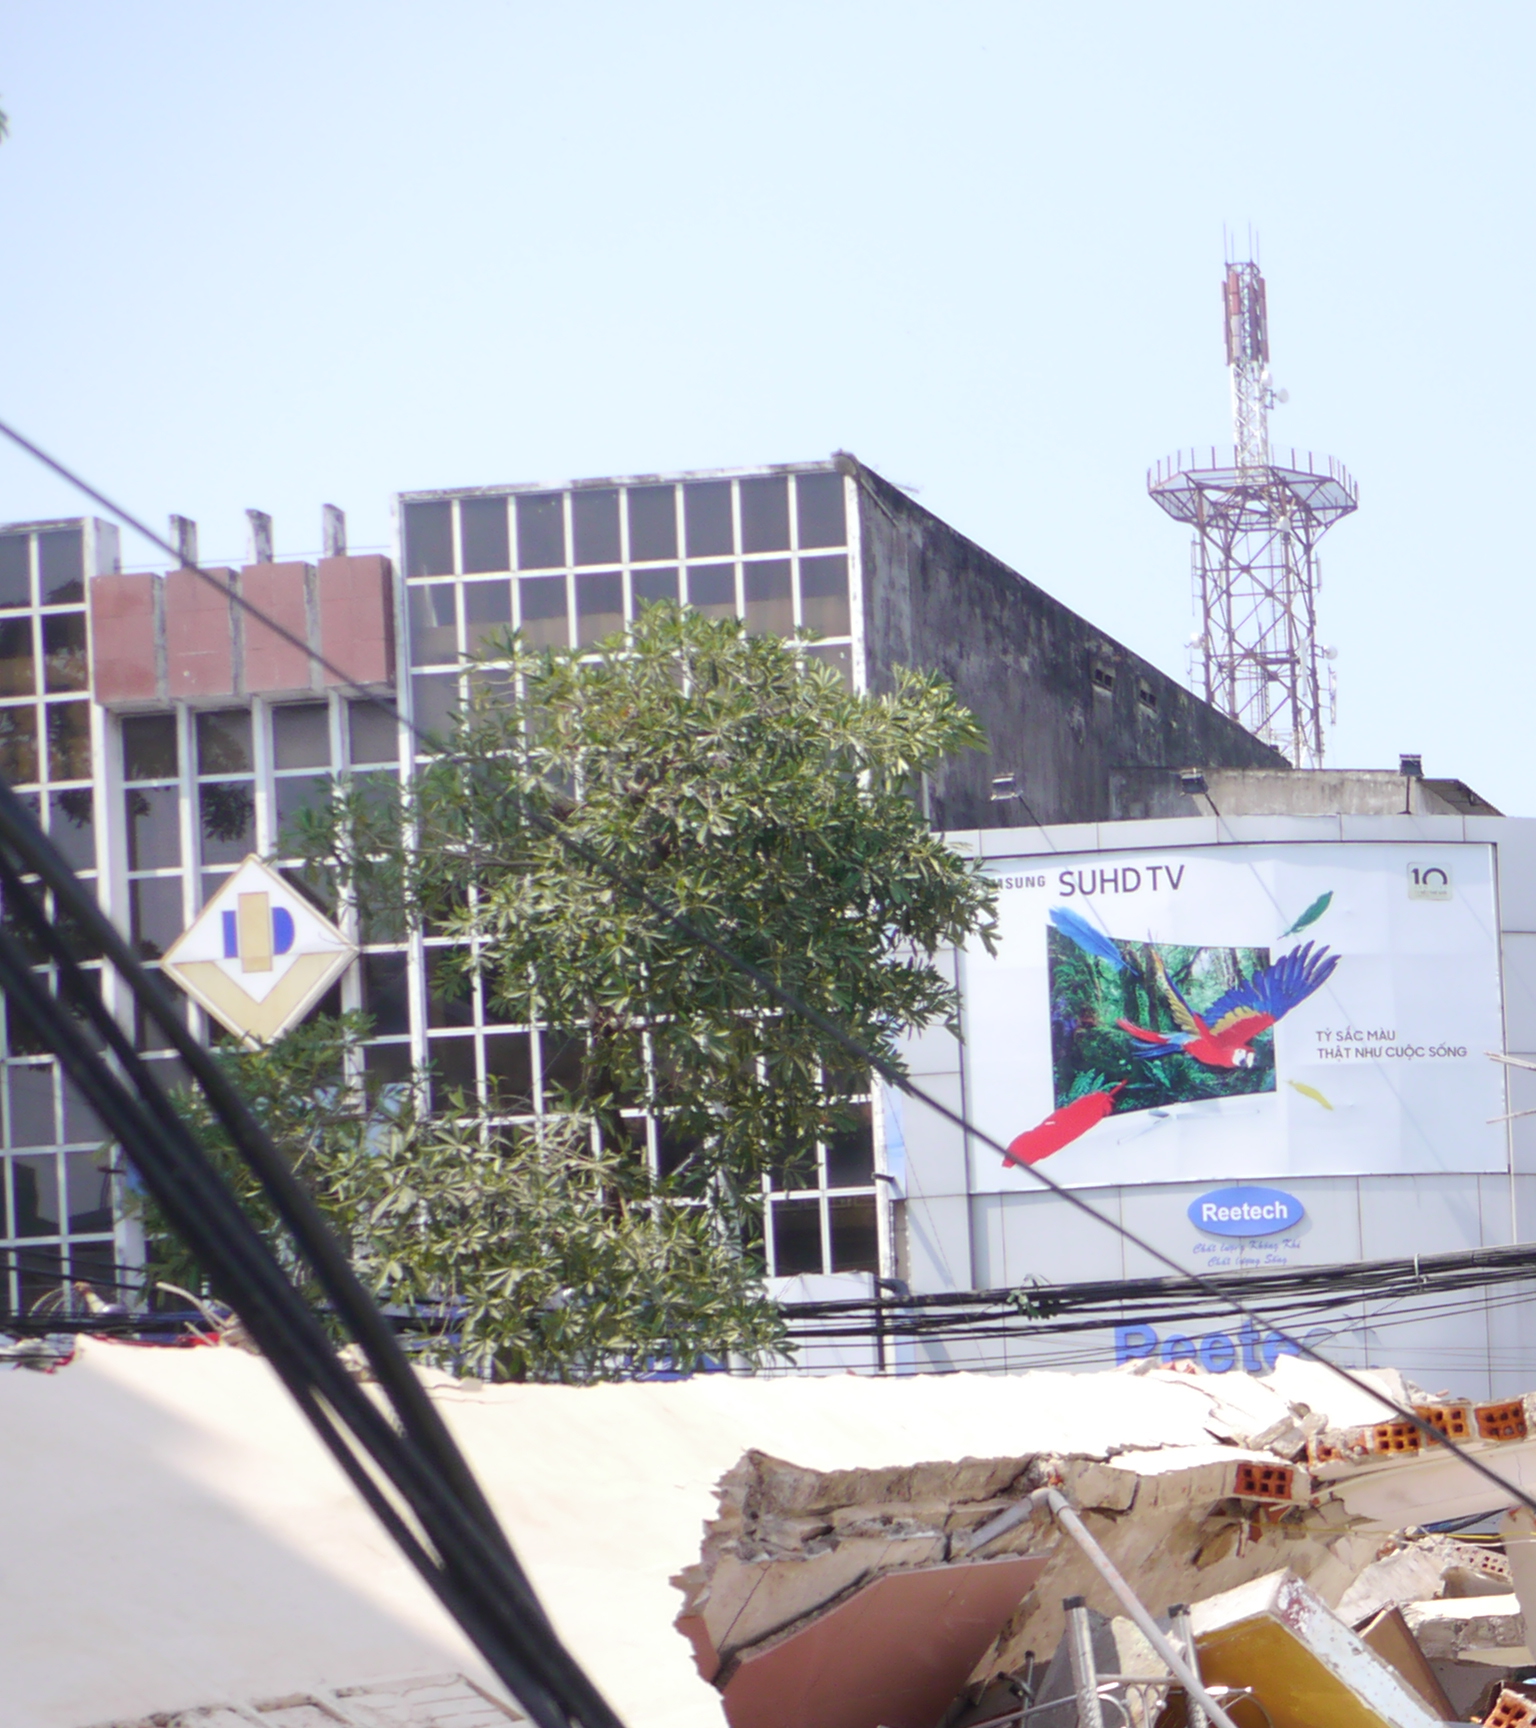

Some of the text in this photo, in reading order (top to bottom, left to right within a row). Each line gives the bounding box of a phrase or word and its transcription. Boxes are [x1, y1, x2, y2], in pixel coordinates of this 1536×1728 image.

[1059, 867, 1141, 897] SUHD
[1146, 865, 1185, 891] TV
[1367, 1027, 1396, 1041] MÀU
[1318, 1045, 1351, 1062] THẬT
[1385, 1044, 1425, 1061] CUỘC
[1429, 1042, 1467, 1058] SỐNG
[1202, 1201, 1288, 1221] Reetech
